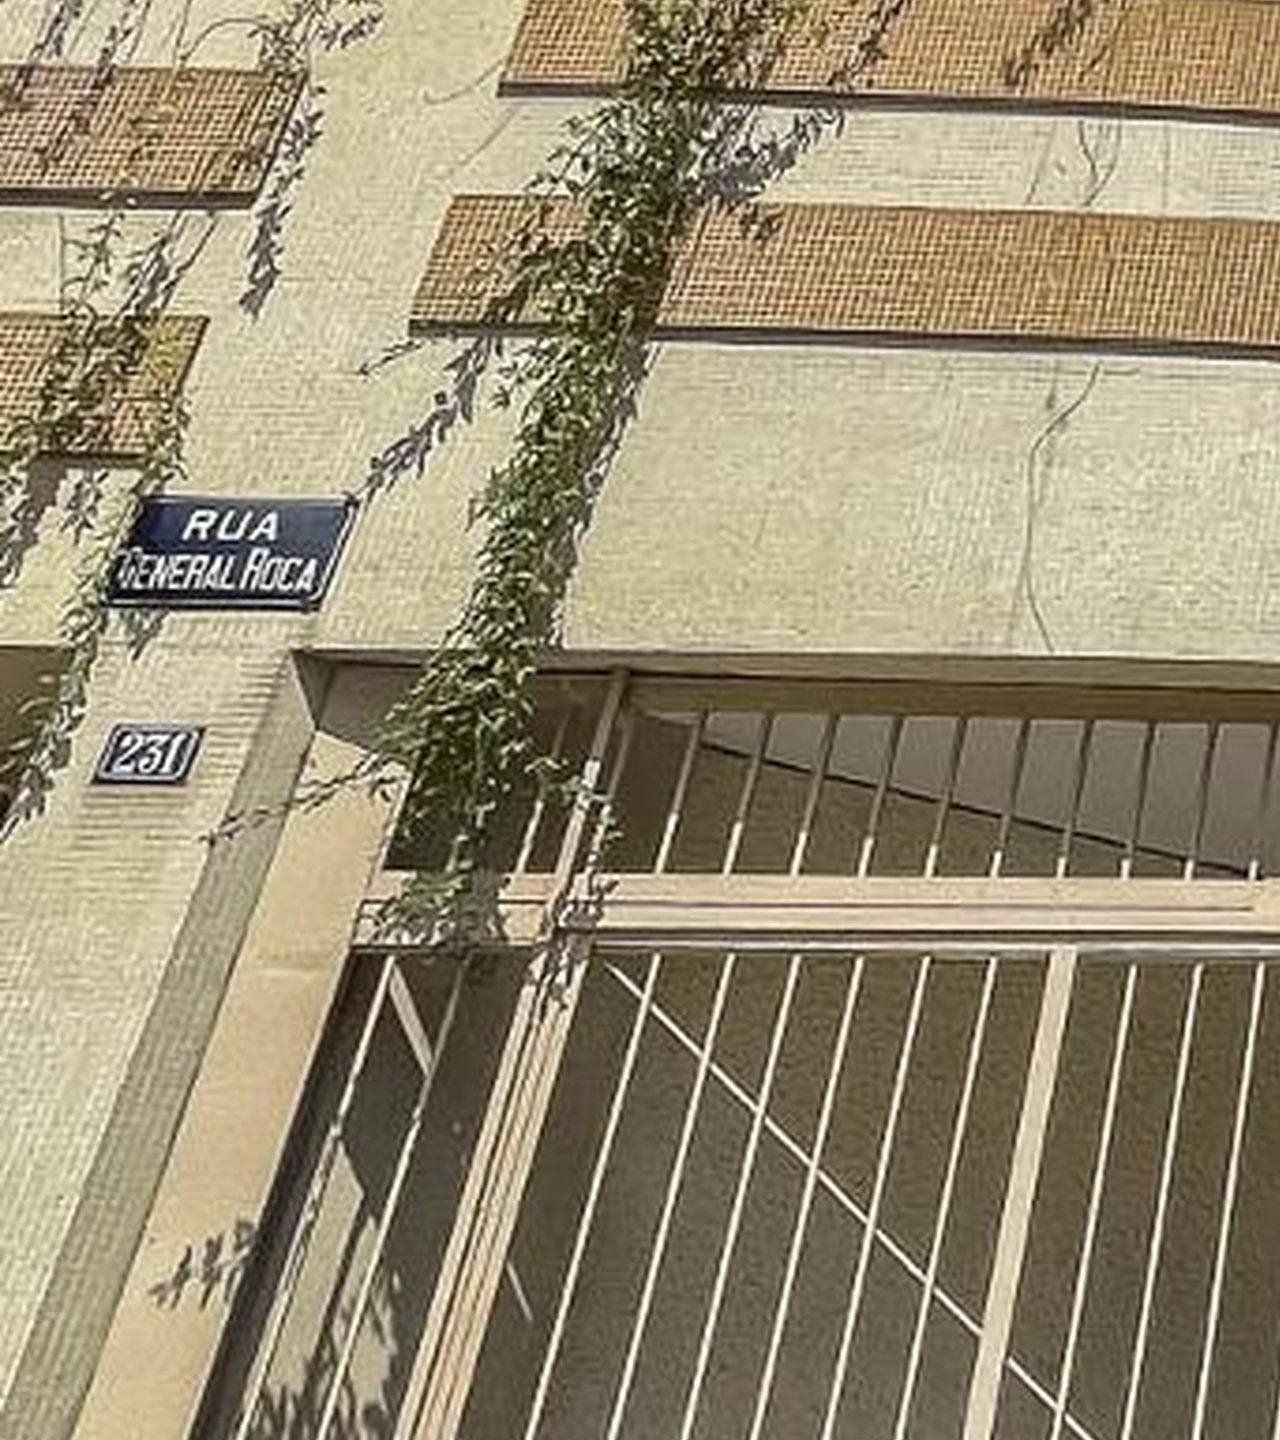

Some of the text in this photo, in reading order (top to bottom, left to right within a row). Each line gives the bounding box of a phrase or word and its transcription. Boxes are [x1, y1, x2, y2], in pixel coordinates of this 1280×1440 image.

[181, 509, 280, 541] RUA
[117, 547, 318, 591] GENERAL ROCA
[111, 733, 187, 774] 231
